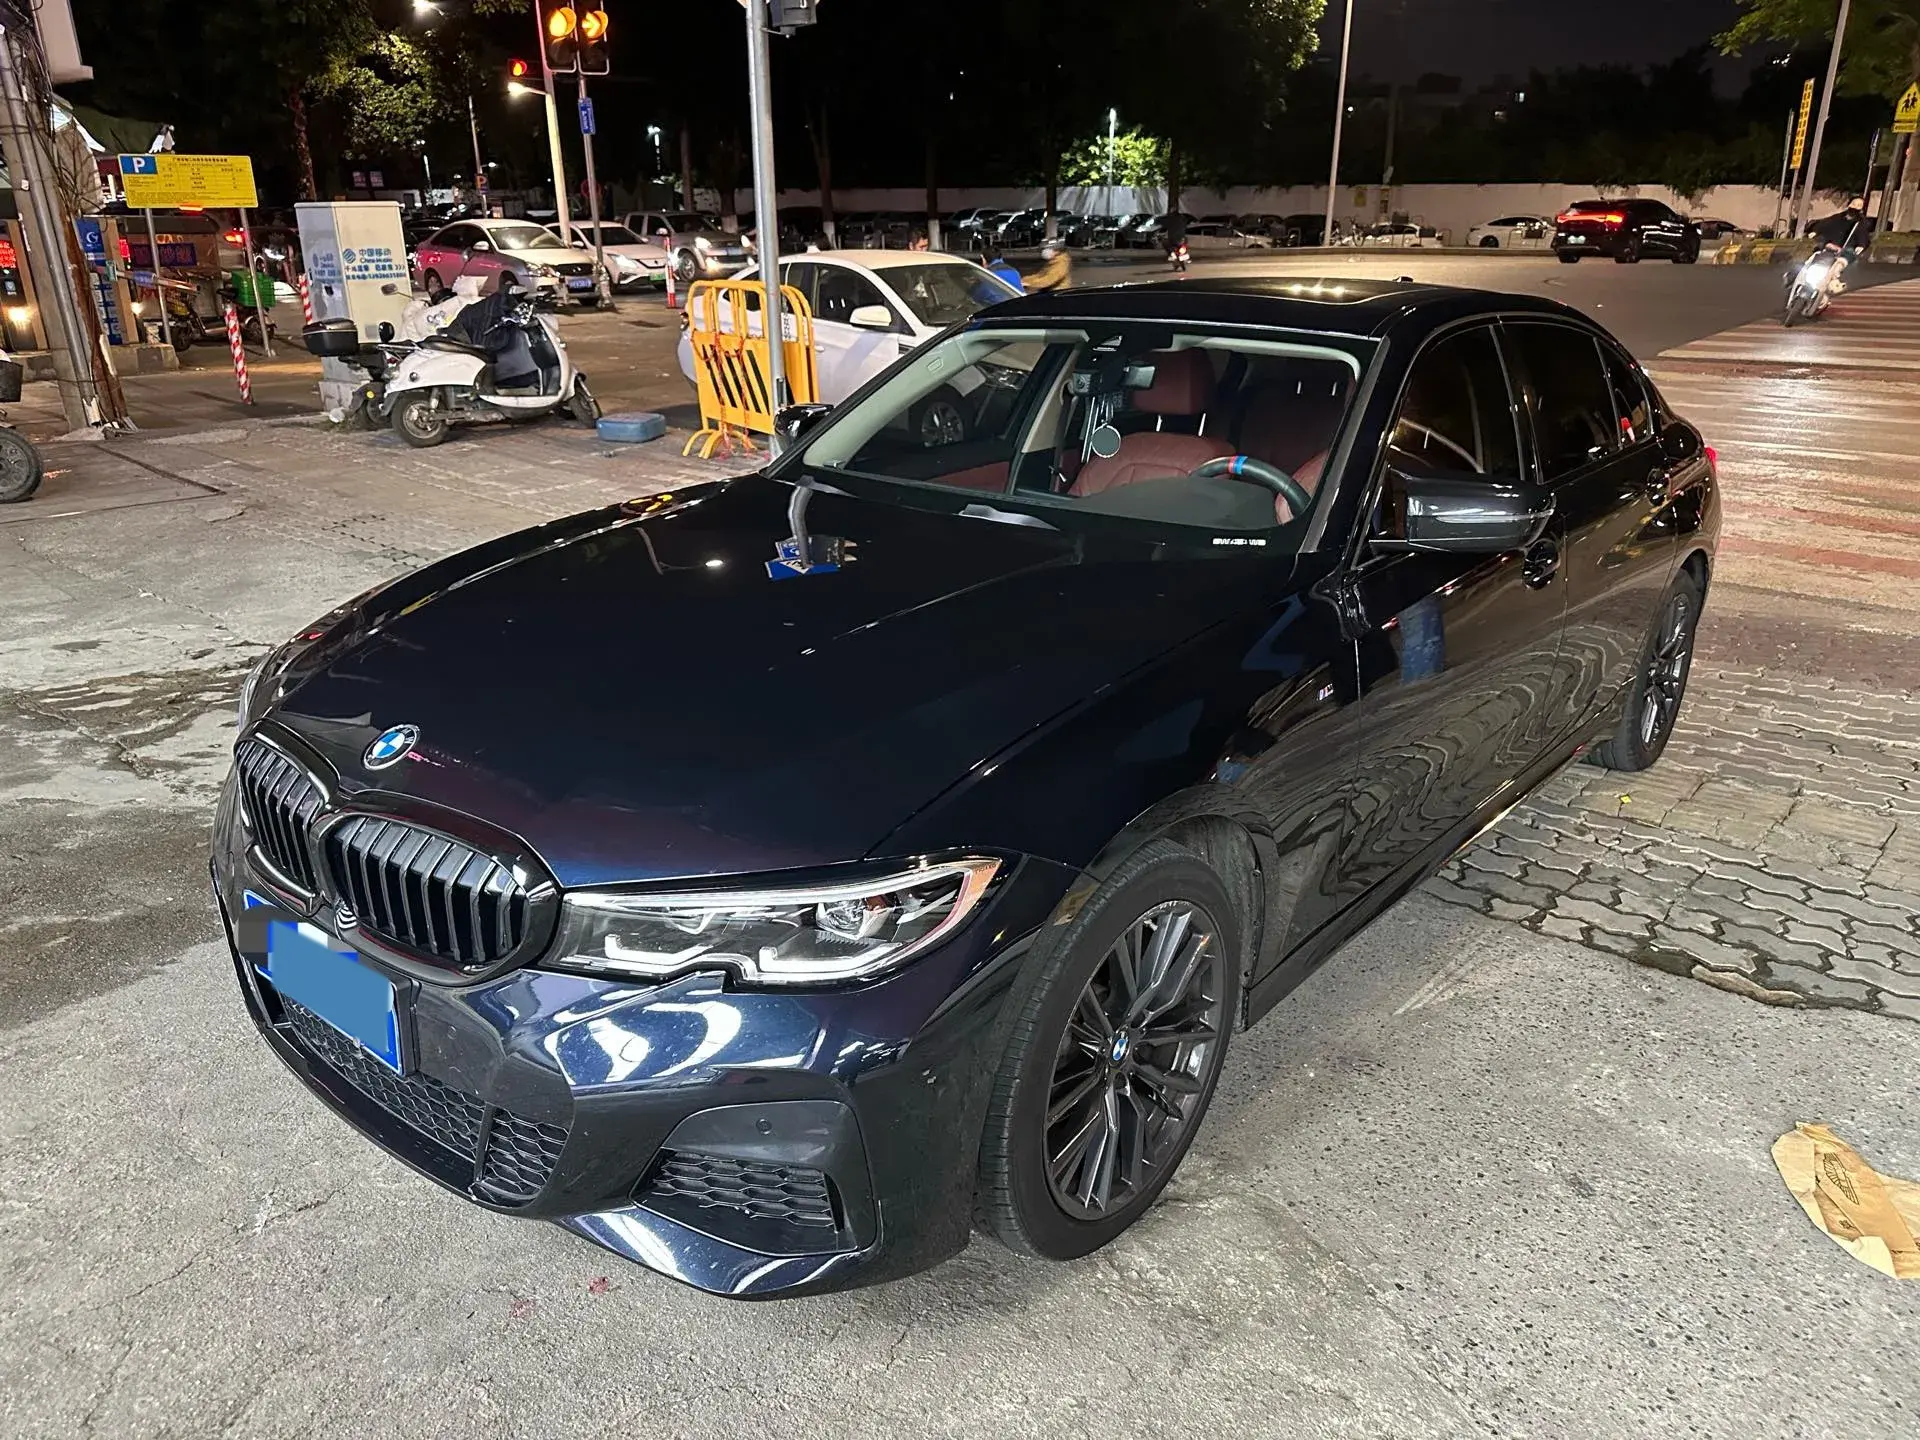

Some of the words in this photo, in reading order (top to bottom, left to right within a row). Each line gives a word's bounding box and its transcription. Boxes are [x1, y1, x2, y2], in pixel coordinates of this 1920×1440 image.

[132, 157, 145, 173] P
[476, 175, 487, 188] P
[359, 248, 391, 257] 中国移动
